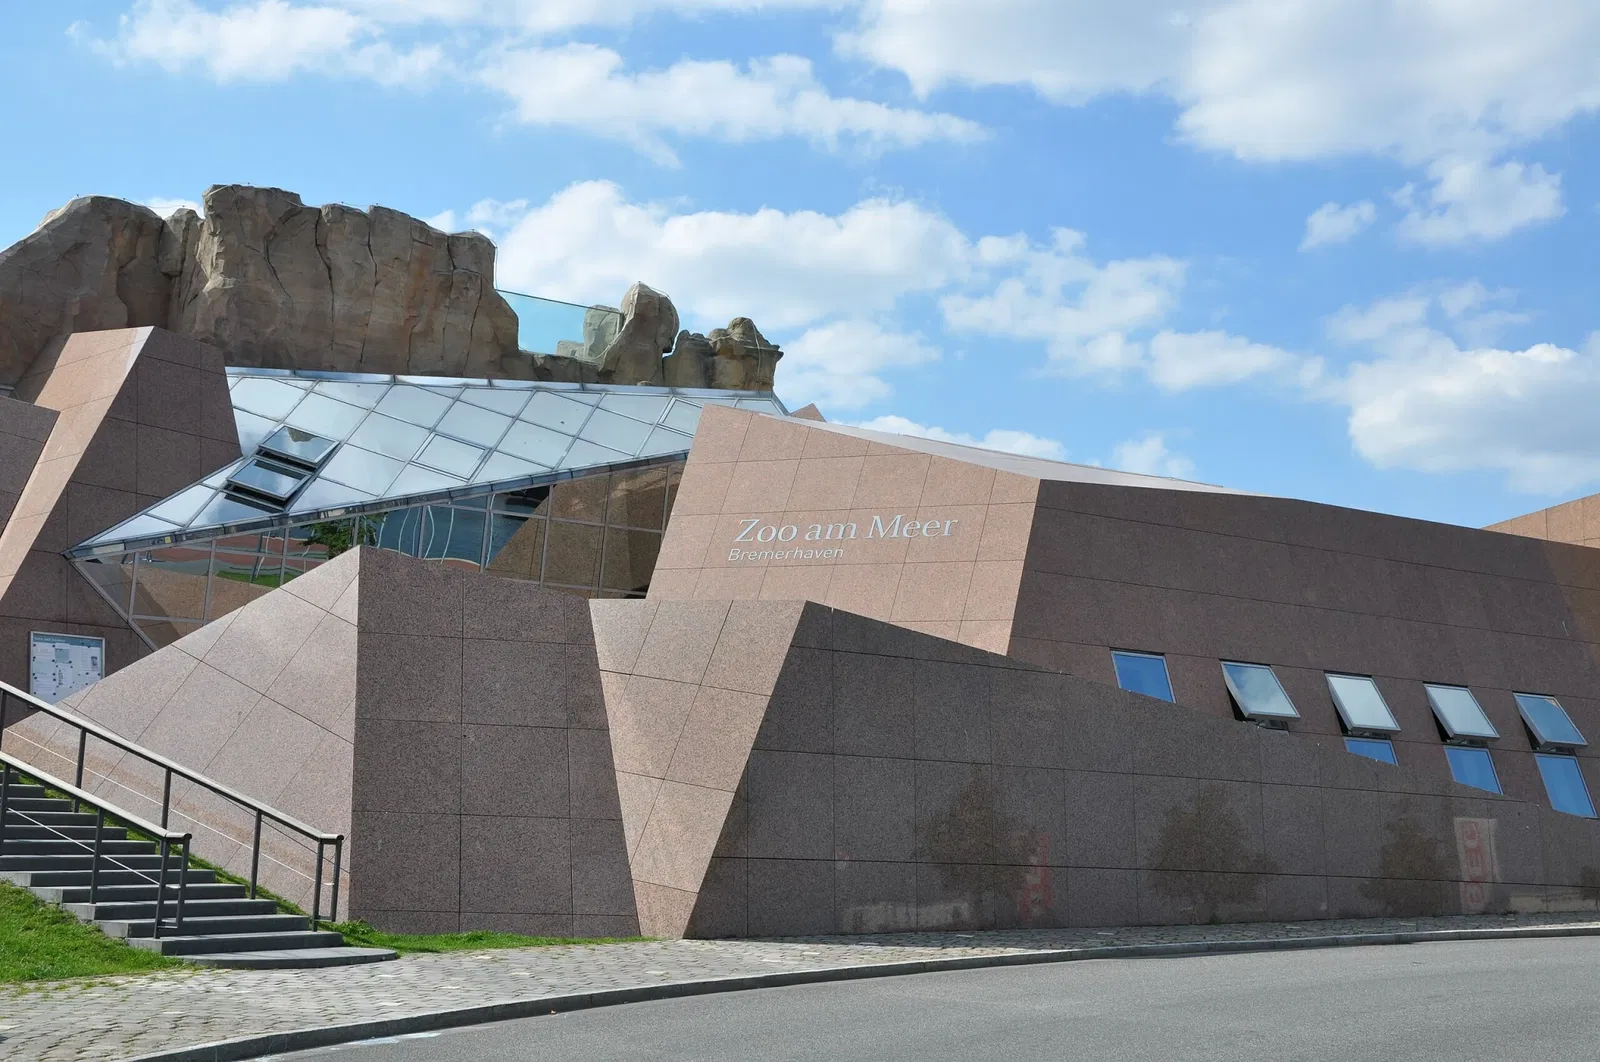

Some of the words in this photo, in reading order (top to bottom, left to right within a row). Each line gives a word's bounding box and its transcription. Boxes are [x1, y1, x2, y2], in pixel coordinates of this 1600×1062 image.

[734, 518, 799, 543] Zoo
[804, 520, 857, 541] am
[867, 514, 959, 539] Meer
[728, 546, 844, 561] Bremerhaven
